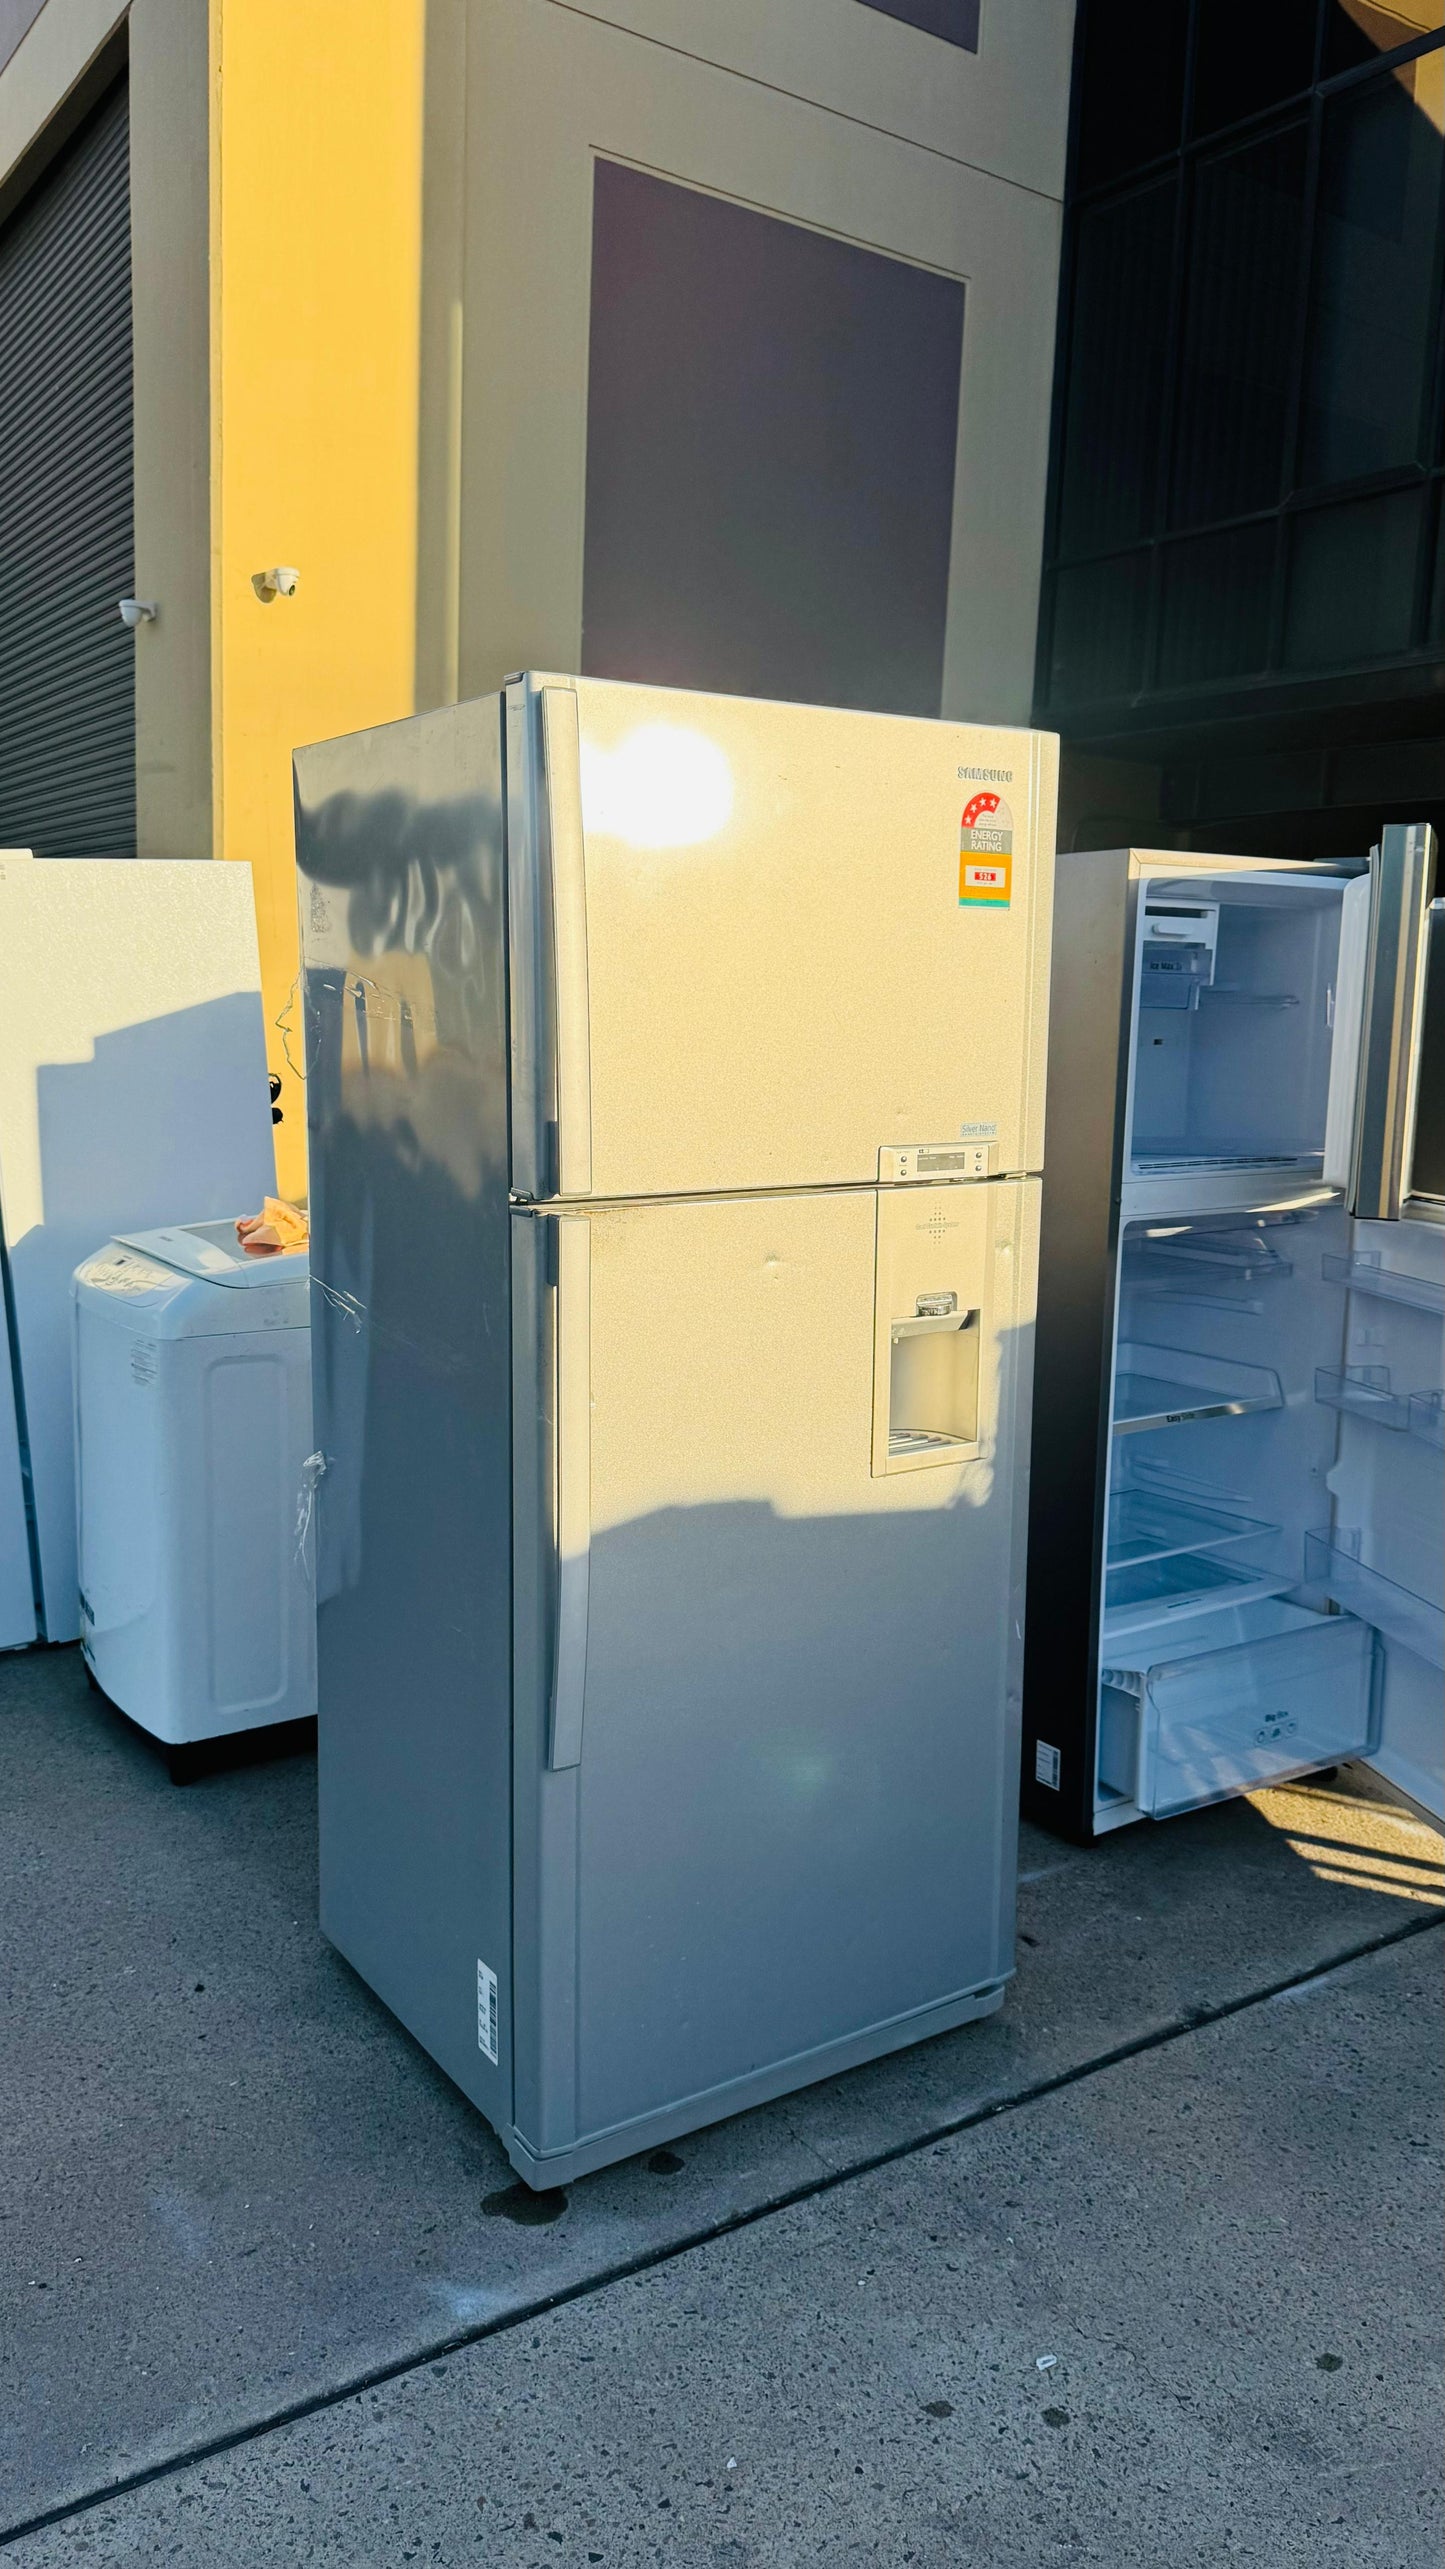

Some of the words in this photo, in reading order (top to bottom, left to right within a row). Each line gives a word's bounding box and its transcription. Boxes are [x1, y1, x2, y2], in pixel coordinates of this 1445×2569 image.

[957, 766, 1012, 783] SAMSUNG
[971, 830, 1003, 842] ENERGY
[971, 841, 1002, 852] RATING
[962, 1124, 978, 1132] Silver
[979, 1124, 996, 1132] Nano
